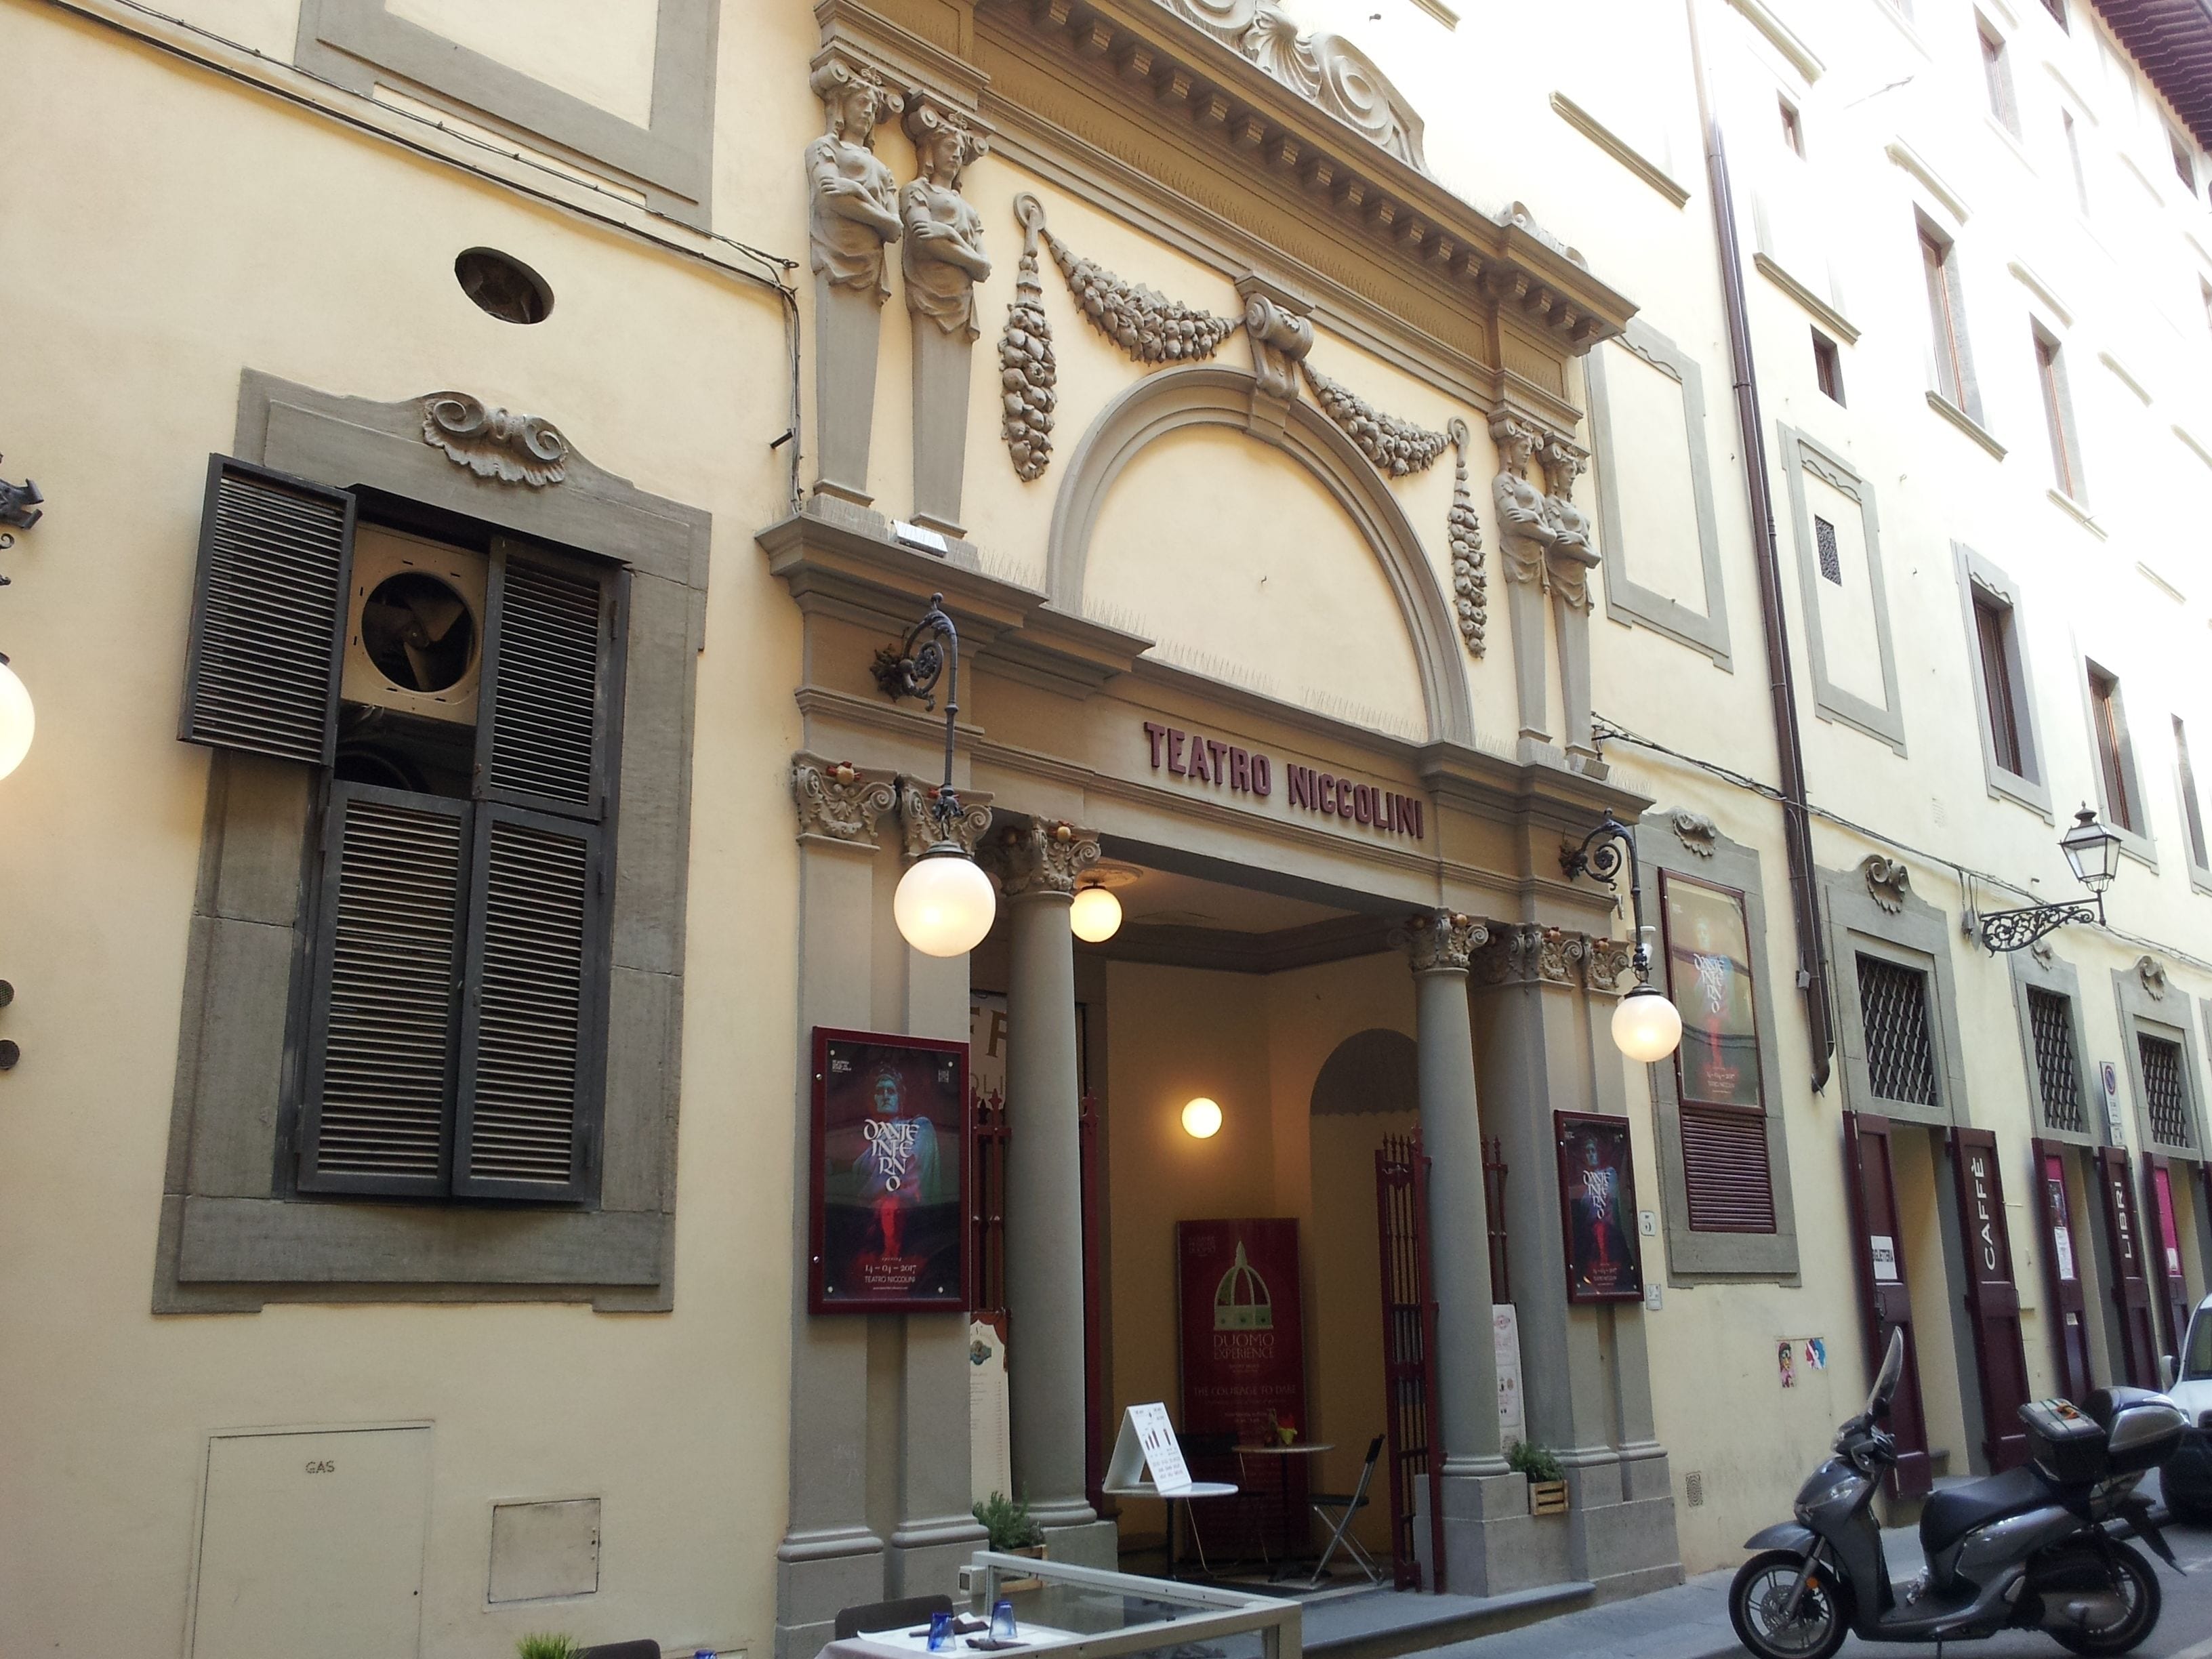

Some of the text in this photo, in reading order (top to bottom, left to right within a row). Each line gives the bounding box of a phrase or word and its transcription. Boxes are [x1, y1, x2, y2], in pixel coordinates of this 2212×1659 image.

[1143, 721, 1424, 838] TEATRO NICCOLINI
[863, 1119, 920, 1141] DANTE
[1971, 1157, 1996, 1271] CAFFÈ
[2114, 1181, 2132, 1258] LIBRI
[1214, 1333, 1274, 1347] DUOMO
[1214, 1347, 1274, 1359] EXPERIENCE
[305, 1460, 335, 1474] GAS
